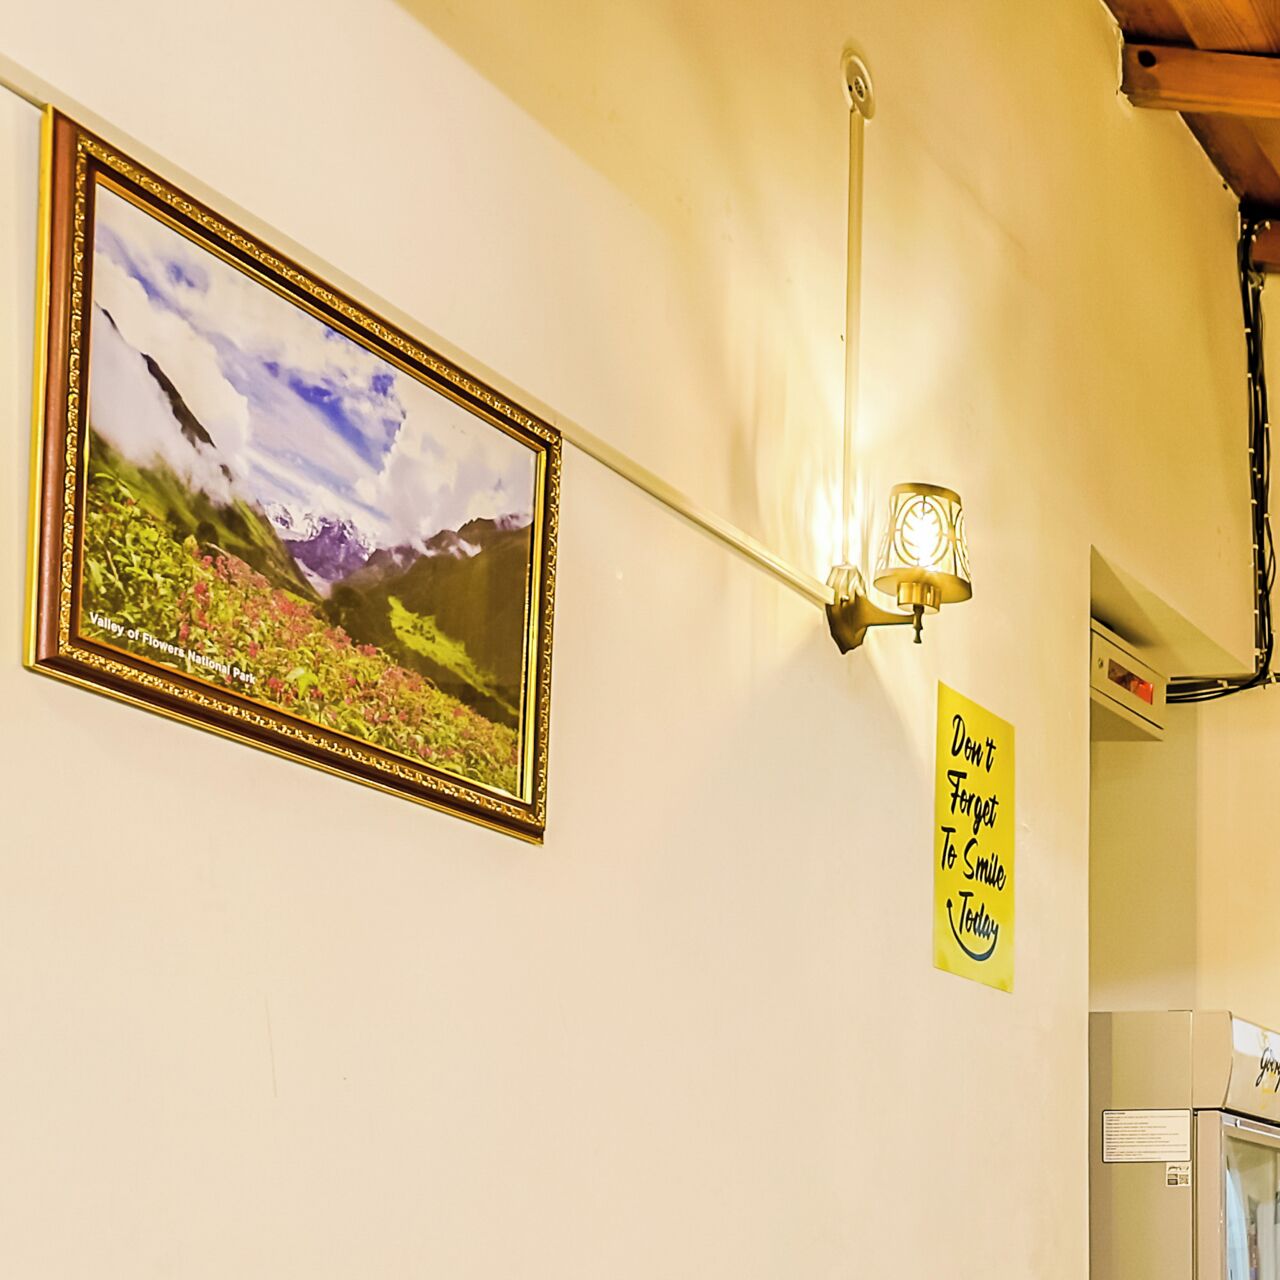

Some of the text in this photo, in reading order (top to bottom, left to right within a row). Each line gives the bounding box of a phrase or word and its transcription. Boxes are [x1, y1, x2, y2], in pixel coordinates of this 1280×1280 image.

[89, 612, 256, 684] Valley of Flowers National Park
[952, 714, 997, 773] Don't
[947, 769, 999, 835] Forget
[941, 826, 1006, 891] To Smile
[958, 890, 999, 941] Today
